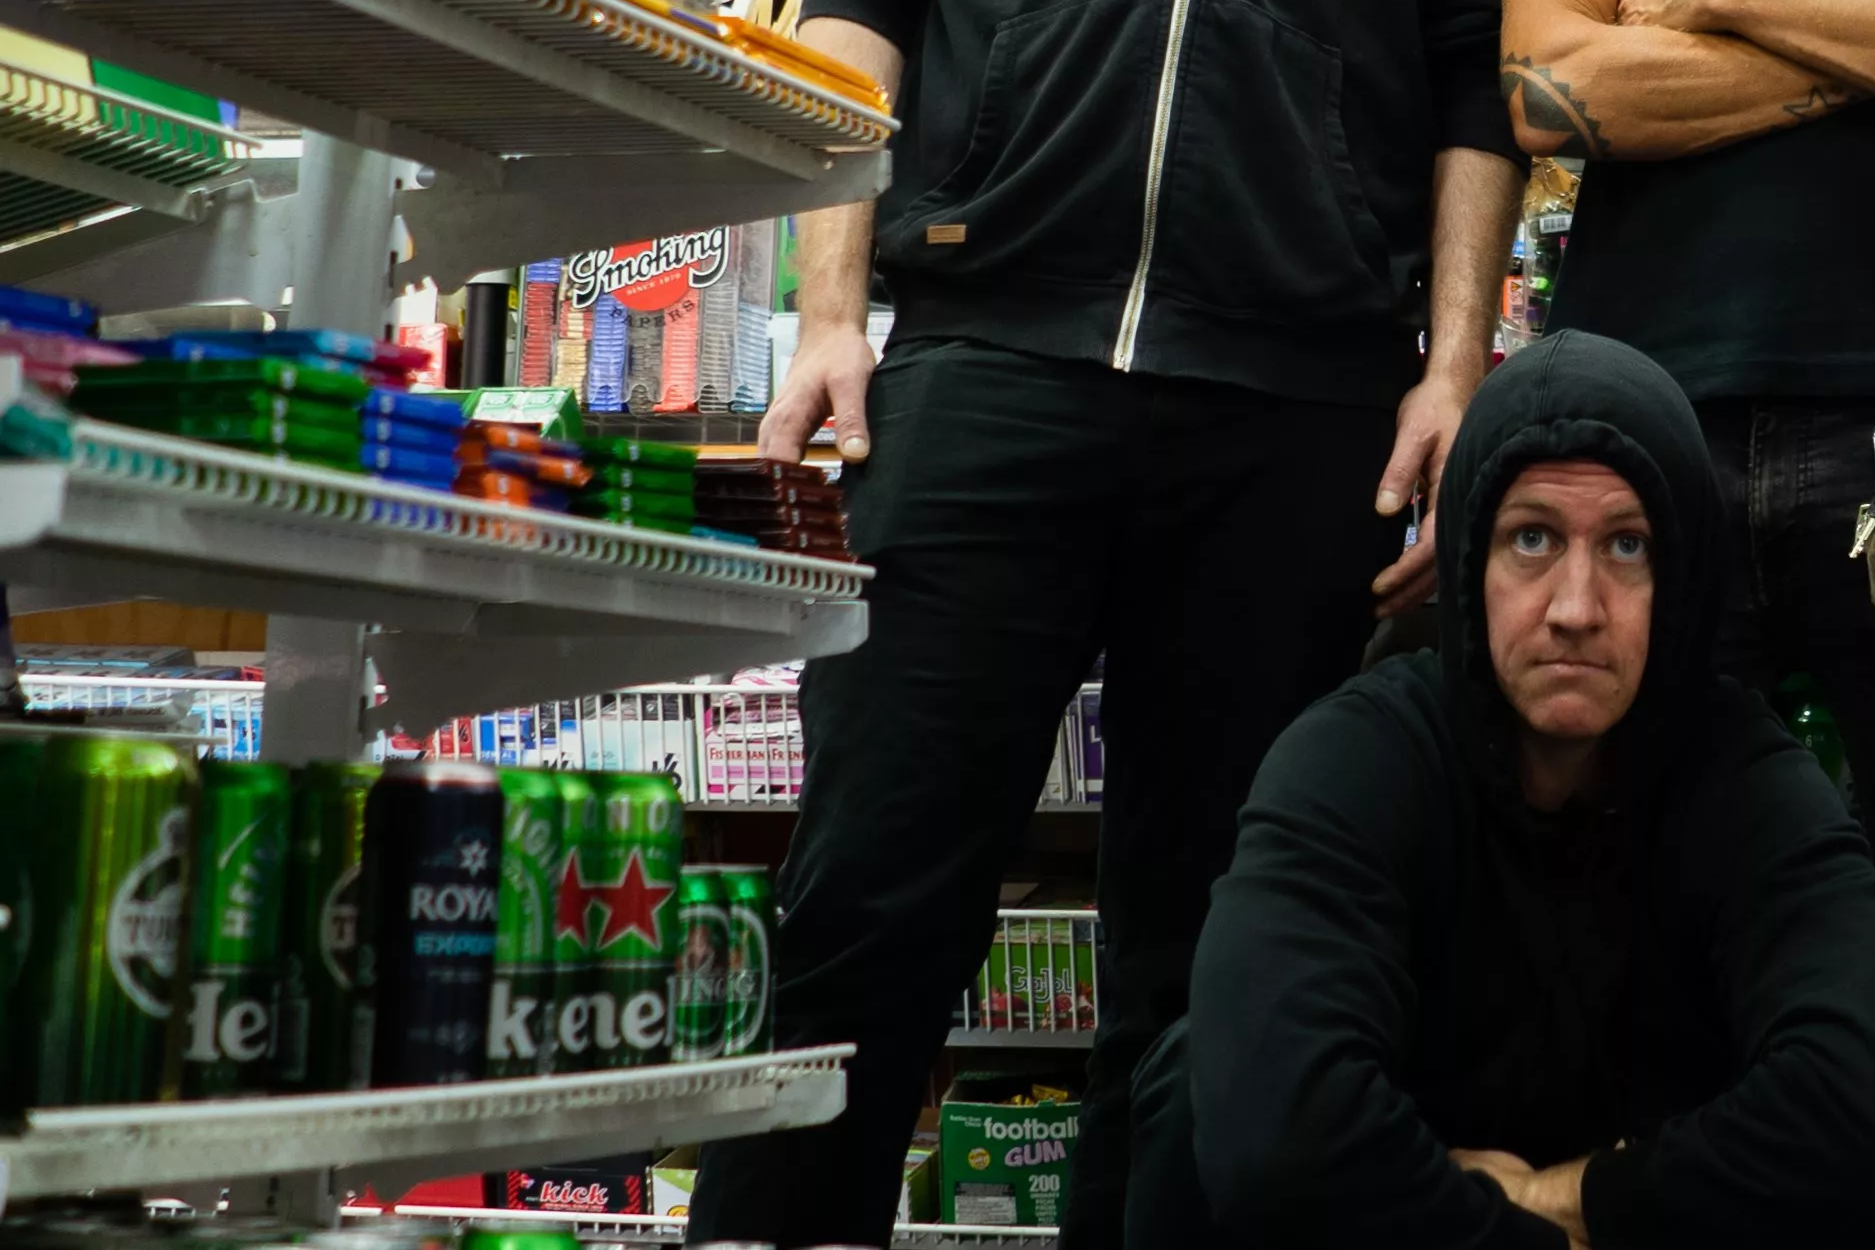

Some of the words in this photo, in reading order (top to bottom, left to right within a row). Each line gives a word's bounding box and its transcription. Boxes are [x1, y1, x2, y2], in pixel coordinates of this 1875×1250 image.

[569, 224, 730, 309] Smoking
[609, 299, 695, 328] PAPERS
[409, 883, 499, 921] ROYA
[983, 1116, 1080, 1140] football
[1004, 1140, 1067, 1167] GUM
[540, 1180, 609, 1205] kick
[1028, 1174, 1060, 1193] 200
